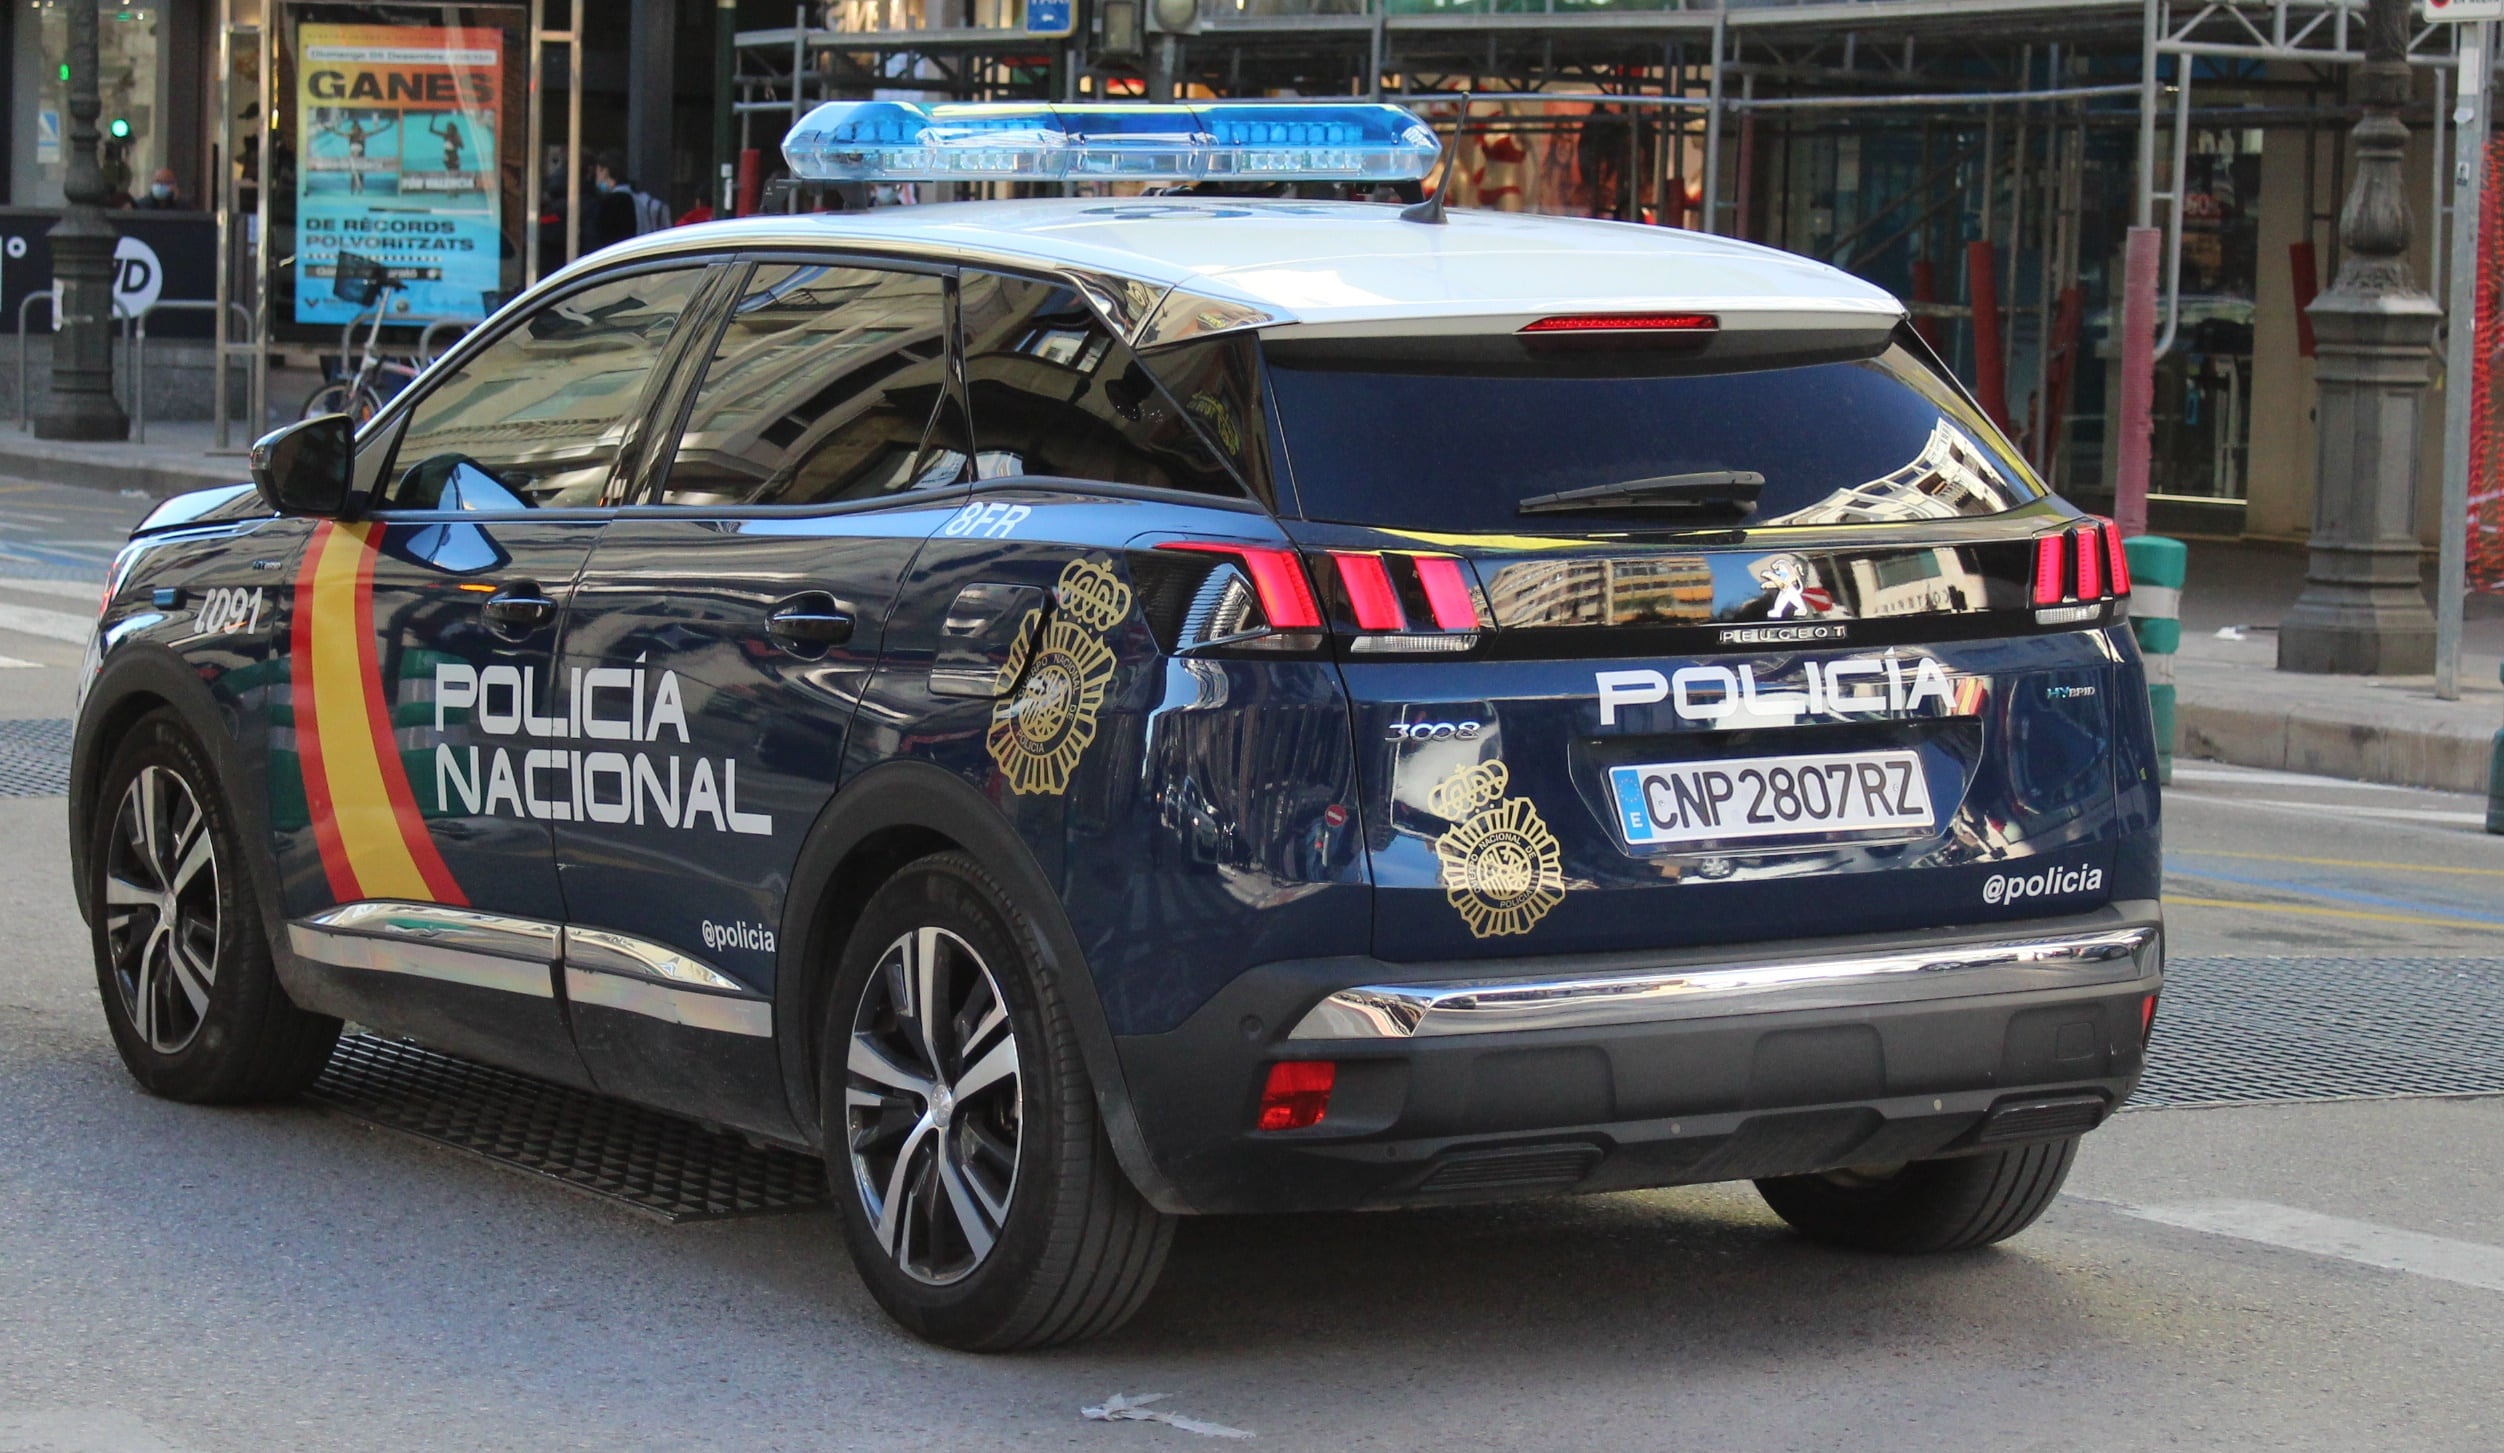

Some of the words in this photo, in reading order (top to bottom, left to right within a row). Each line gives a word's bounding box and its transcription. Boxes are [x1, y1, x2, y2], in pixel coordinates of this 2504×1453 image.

[308, 70, 496, 103] GANES
[306, 218, 336, 231] DE
[305, 234, 475, 251] POLVORITZATS
[945, 501, 1032, 538] 8FR
[1719, 625, 1847, 644] PEUGEOT
[1053, 654, 1081, 695] NACIONAL
[1595, 646, 1958, 726] POLICÍA
[435, 651, 690, 743] POLICÍA
[2046, 686, 2096, 699] HYBRID
[1066, 704, 1077, 721] DE
[1015, 730, 1045, 753] POLICIA
[1384, 721, 1481, 741] 3008
[435, 743, 773, 835] NACIONAL
[1630, 812, 1643, 828] E
[1478, 832, 1522, 850] NACIONAL
[1525, 845, 1537, 860] DE
[1982, 863, 2103, 906] @policia
[701, 919, 776, 953] @policia
